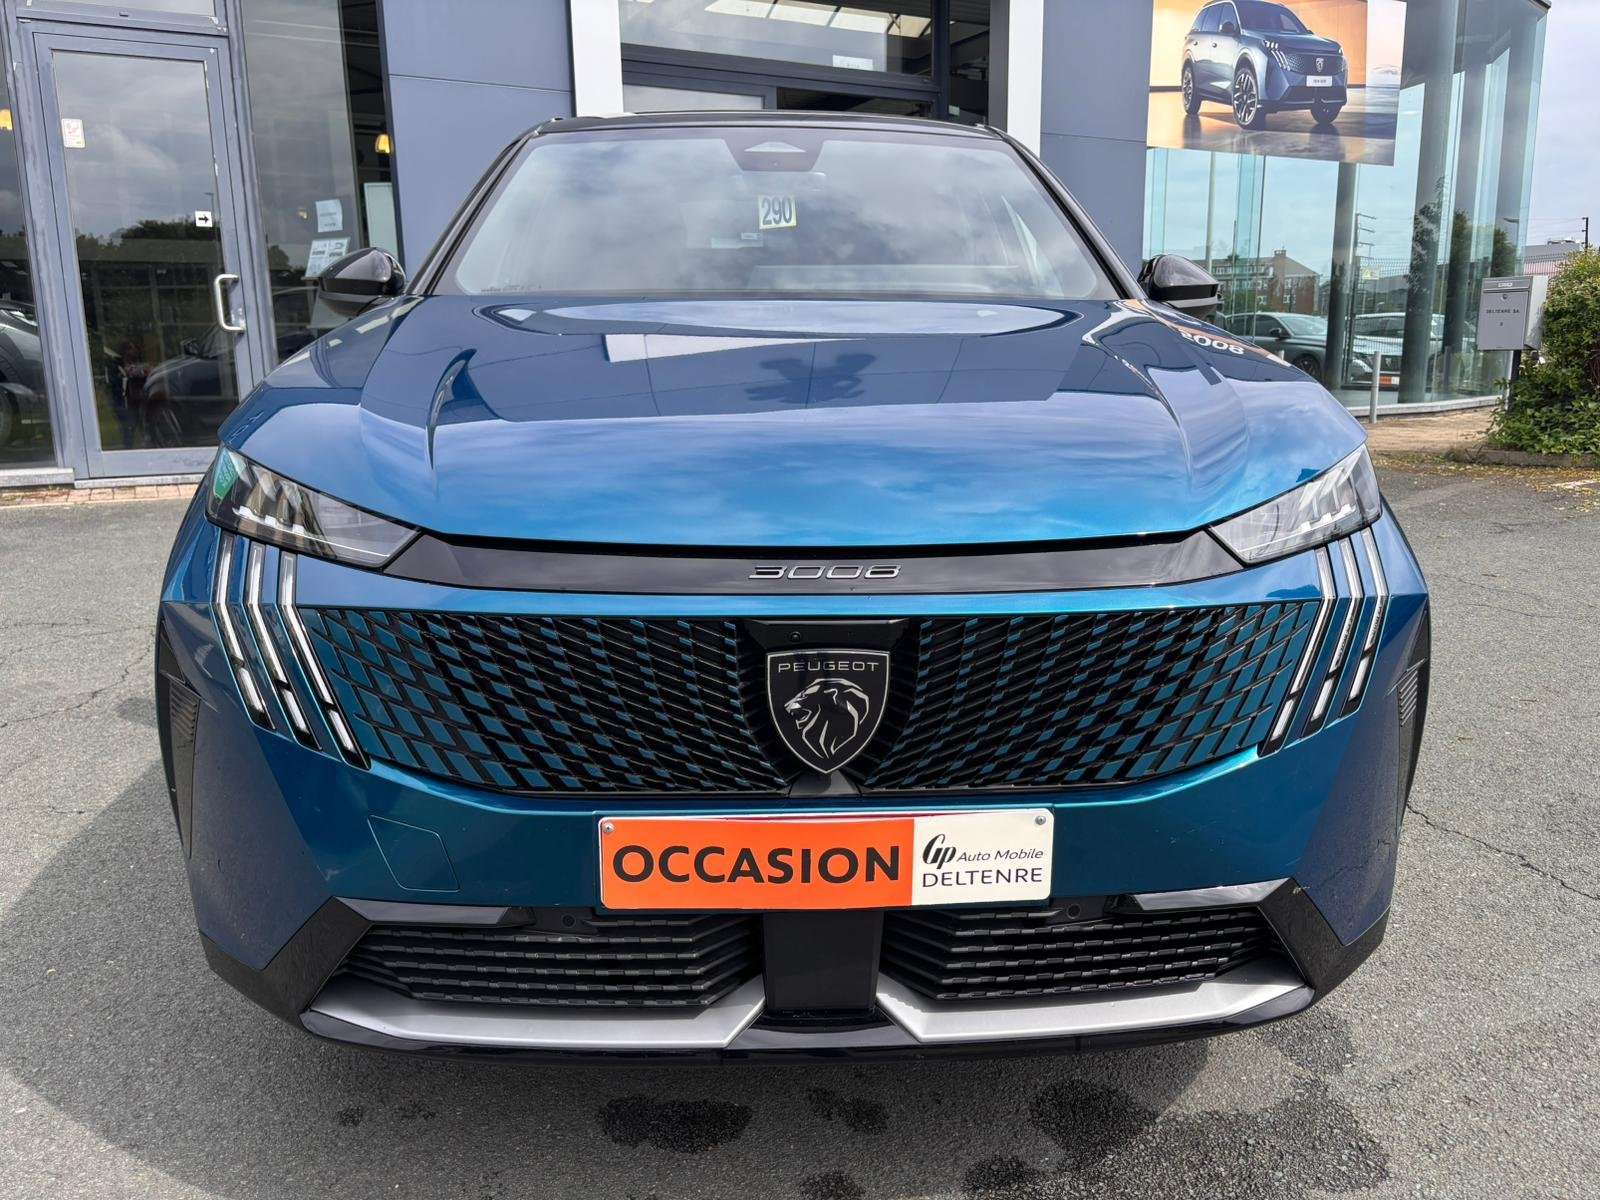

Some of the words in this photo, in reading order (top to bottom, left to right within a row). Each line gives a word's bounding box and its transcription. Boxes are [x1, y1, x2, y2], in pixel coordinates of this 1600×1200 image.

[761, 197, 792, 225] 290
[748, 564, 901, 579] 3008
[778, 661, 880, 673] PEUGEOT
[956, 851, 991, 862] Auto
[994, 847, 1044, 860] Mobile
[612, 844, 900, 884] OCCASION
[922, 867, 1043, 888] DELTENRE
